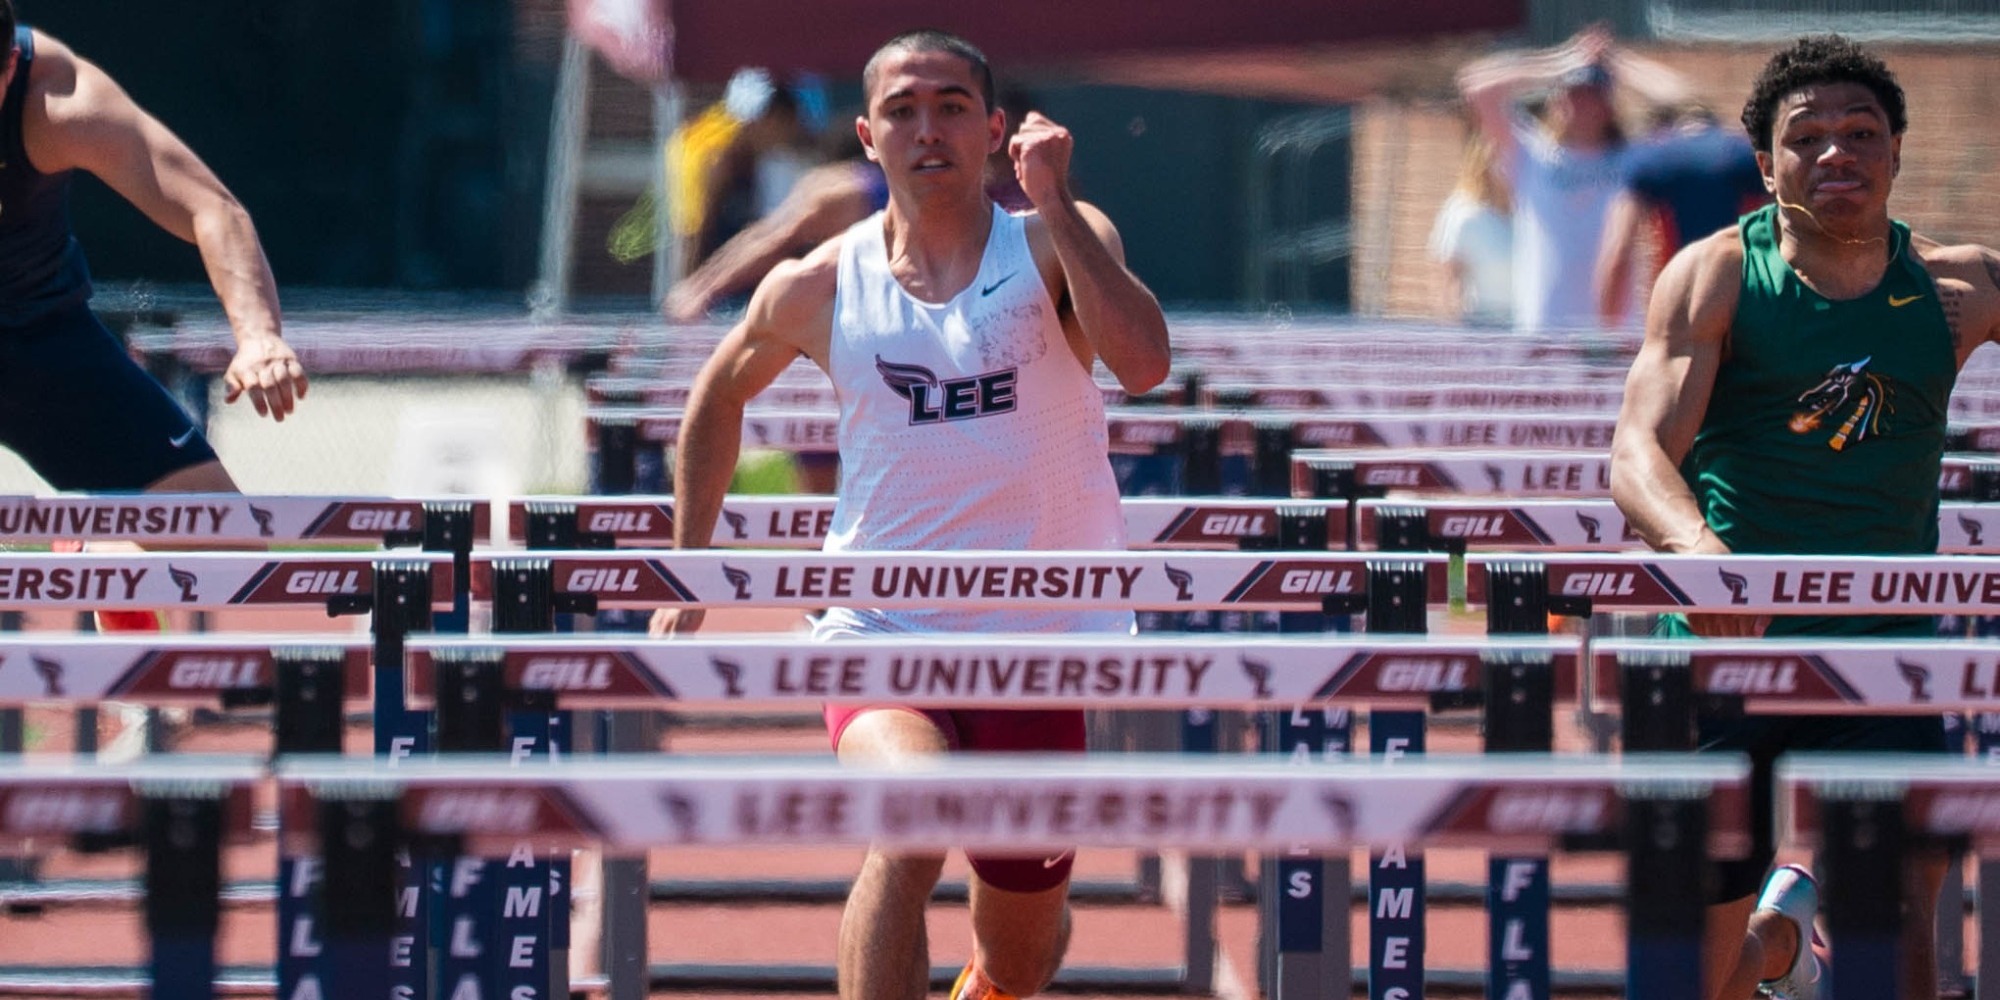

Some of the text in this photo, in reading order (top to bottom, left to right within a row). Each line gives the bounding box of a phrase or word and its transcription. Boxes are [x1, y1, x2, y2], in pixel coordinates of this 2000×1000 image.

[905, 366, 1019, 427] LEE
[1523, 465, 1583, 490] LEE
[0, 506, 231, 537] UNIVERSITY
[347, 509, 412, 531] GILL
[588, 511, 653, 533] GILL
[769, 511, 836, 538] LEE
[1200, 515, 1266, 537] GILL
[1441, 516, 1505, 538] GILL
[285, 570, 360, 595] GILL
[566, 568, 641, 593] GILL
[775, 566, 1143, 599] LEE UNIVERSITY
[1280, 570, 1354, 595] GILL
[1562, 571, 1637, 596] GILL
[1771, 571, 1856, 604] LEE
[169, 659, 259, 688] GILL
[521, 660, 615, 690] GILL
[775, 656, 1214, 698] LEE UNIVERSITY
[1376, 660, 1470, 692] GILL
[1706, 662, 1799, 694] GILL
[734, 784, 1290, 840] LEE UNIVERSITY
